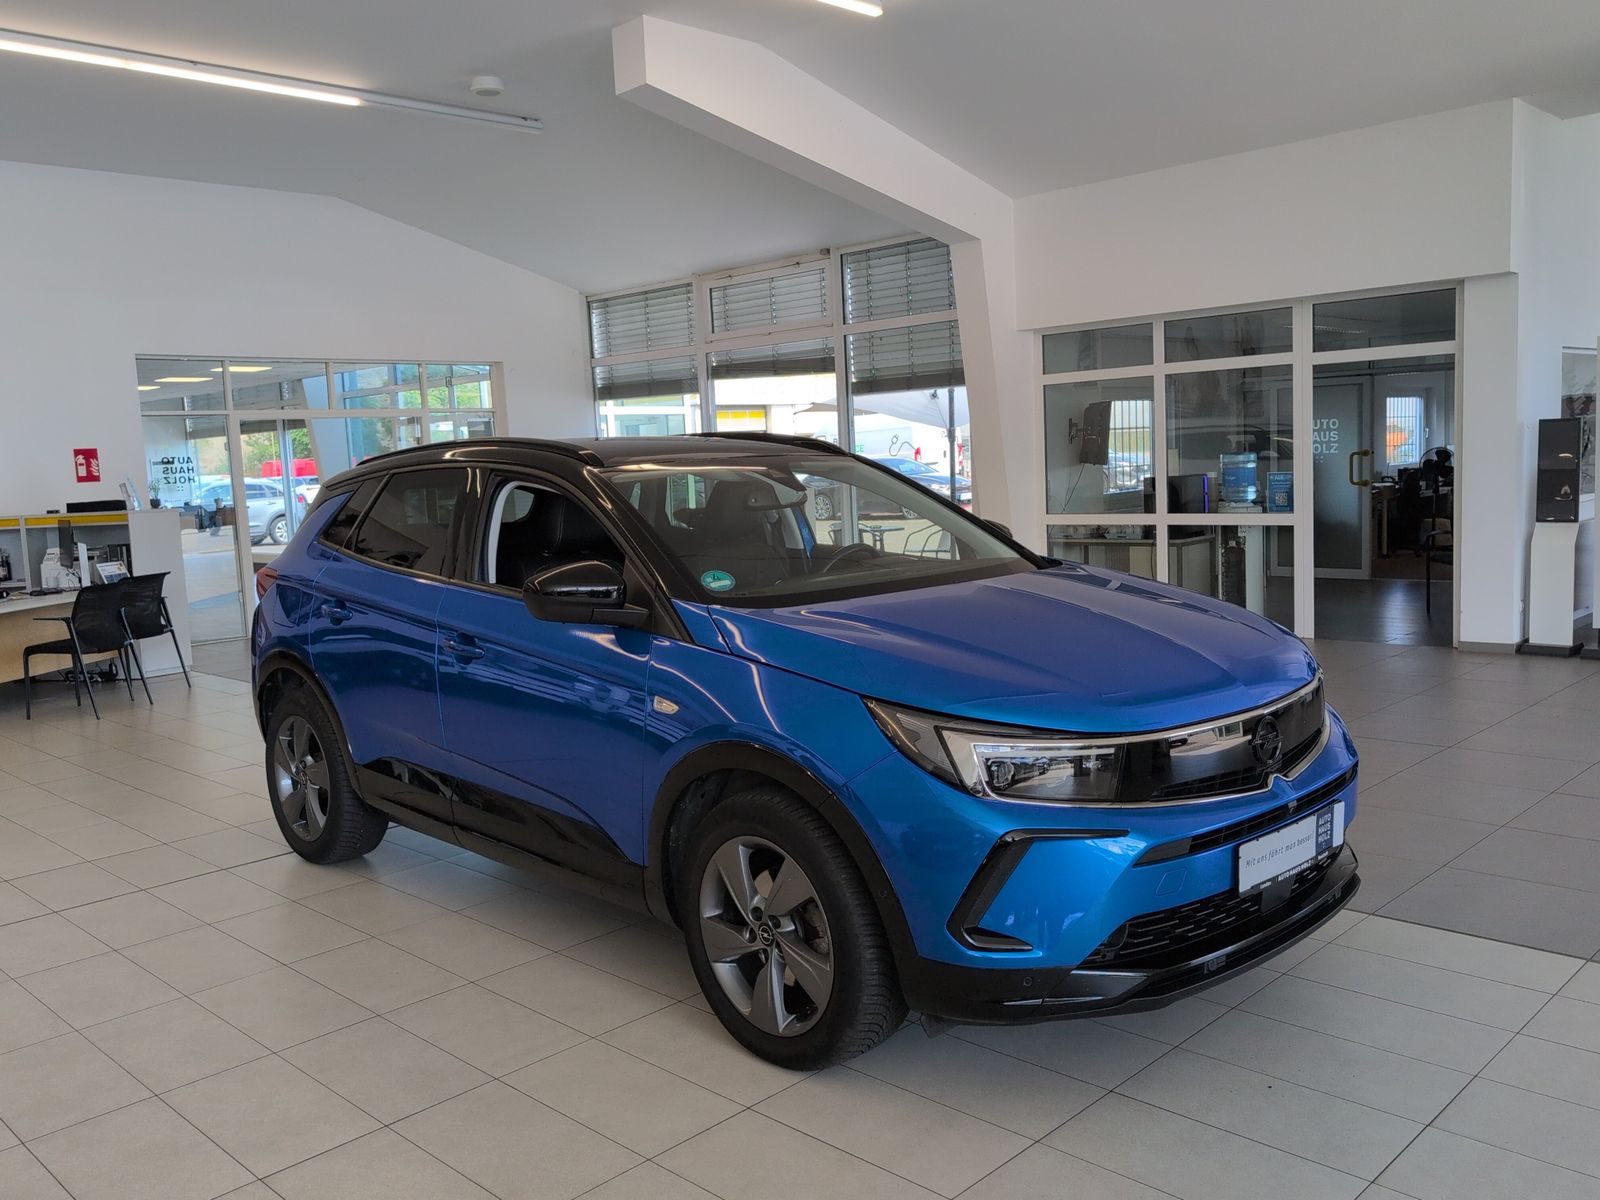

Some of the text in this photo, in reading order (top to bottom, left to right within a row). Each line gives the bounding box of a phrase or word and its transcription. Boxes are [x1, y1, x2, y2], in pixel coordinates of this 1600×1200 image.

[1312, 418, 1339, 430] UTO
[1313, 431, 1339, 442] AUS
[1313, 443, 1339, 454] OLZ
[1319, 813, 1332, 825] AUTO
[1318, 821, 1331, 835] HAUS
[1318, 830, 1331, 844] HOLZ
